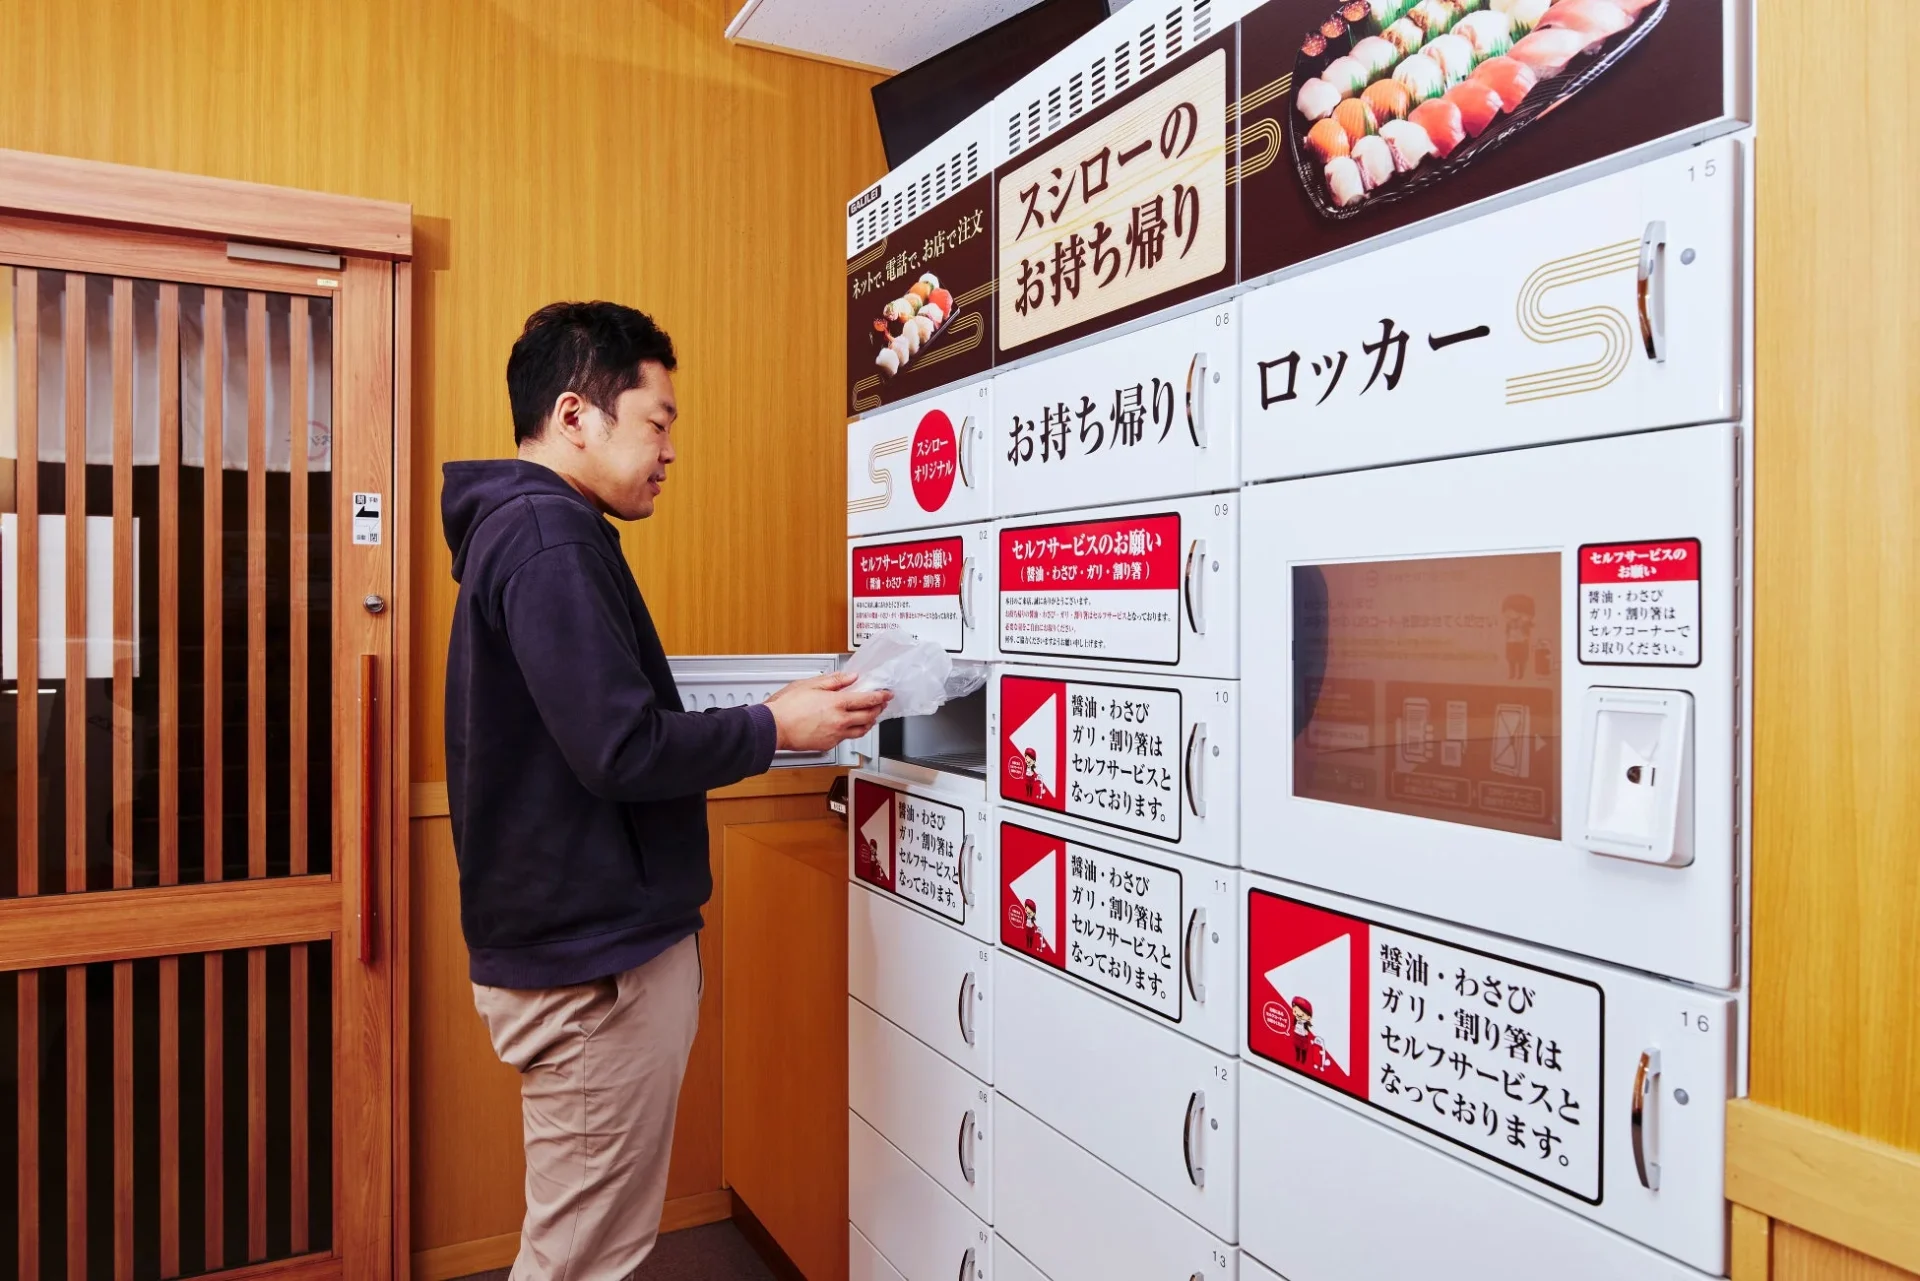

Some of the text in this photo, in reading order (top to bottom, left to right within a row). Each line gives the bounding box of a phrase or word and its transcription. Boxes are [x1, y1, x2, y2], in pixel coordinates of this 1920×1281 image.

[1015, 101, 1198, 241] スシローの
[1686, 158, 1716, 182] 15
[853, 208, 983, 300] ネットで、電話で、お店で注文
[1015, 184, 1200, 316] お持ち帰り
[1216, 312, 1229, 326] 08
[1256, 318, 1490, 411] ロッカー
[979, 387, 988, 397] 01
[1007, 377, 1175, 467] お持ち帰り
[916, 438, 948, 457] スシロー
[914, 460, 954, 482] オリジナル
[1214, 503, 1229, 516] 09
[979, 530, 987, 540] 02
[1012, 528, 1162, 560] セルフサービスのお願い
[860, 548, 952, 572] セルフサービスのお願い
[1590, 548, 1687, 564] セルフサービスの
[1617, 564, 1657, 579] お願い
[1588, 590, 1663, 604] 醤油・わさび
[1590, 606, 1676, 620] ガリ・割り箸は
[1588, 625, 1690, 637] セルフコーナーで
[1588, 641, 1685, 656] お取りください。
[1071, 694, 1150, 724] 醤油・わさび
[1215, 691, 1229, 703] 10
[1072, 725, 1163, 757] ガリ・割り箸は
[1071, 753, 1172, 791] セルフサービスと
[899, 801, 946, 830] 醤油・わさび
[1071, 780, 1166, 822] なっております。
[978, 811, 987, 822] 04
[899, 827, 954, 858] ガリ・割り箸は
[899, 847, 959, 885] セルフサービスと
[1071, 855, 1150, 897] 醤油・わさび
[899, 869, 956, 908] なっております。
[1214, 879, 1227, 893] 11
[1072, 885, 1163, 934] ガリ・割り箸は
[1071, 914, 1172, 970] セルフサービスと
[1071, 941, 1166, 999] なっております。
[1380, 944, 1536, 1015] 醤油・わさび
[1381, 986, 1562, 1072] ガリ・割り箸は
[1681, 1011, 1709, 1032] 16
[1214, 1065, 1228, 1080] 12
[1380, 1025, 1580, 1126] セルフサービスと
[1381, 1063, 1570, 1167] なっております。
[979, 1231, 988, 1244] 07
[1212, 1250, 1226, 1268] 13
